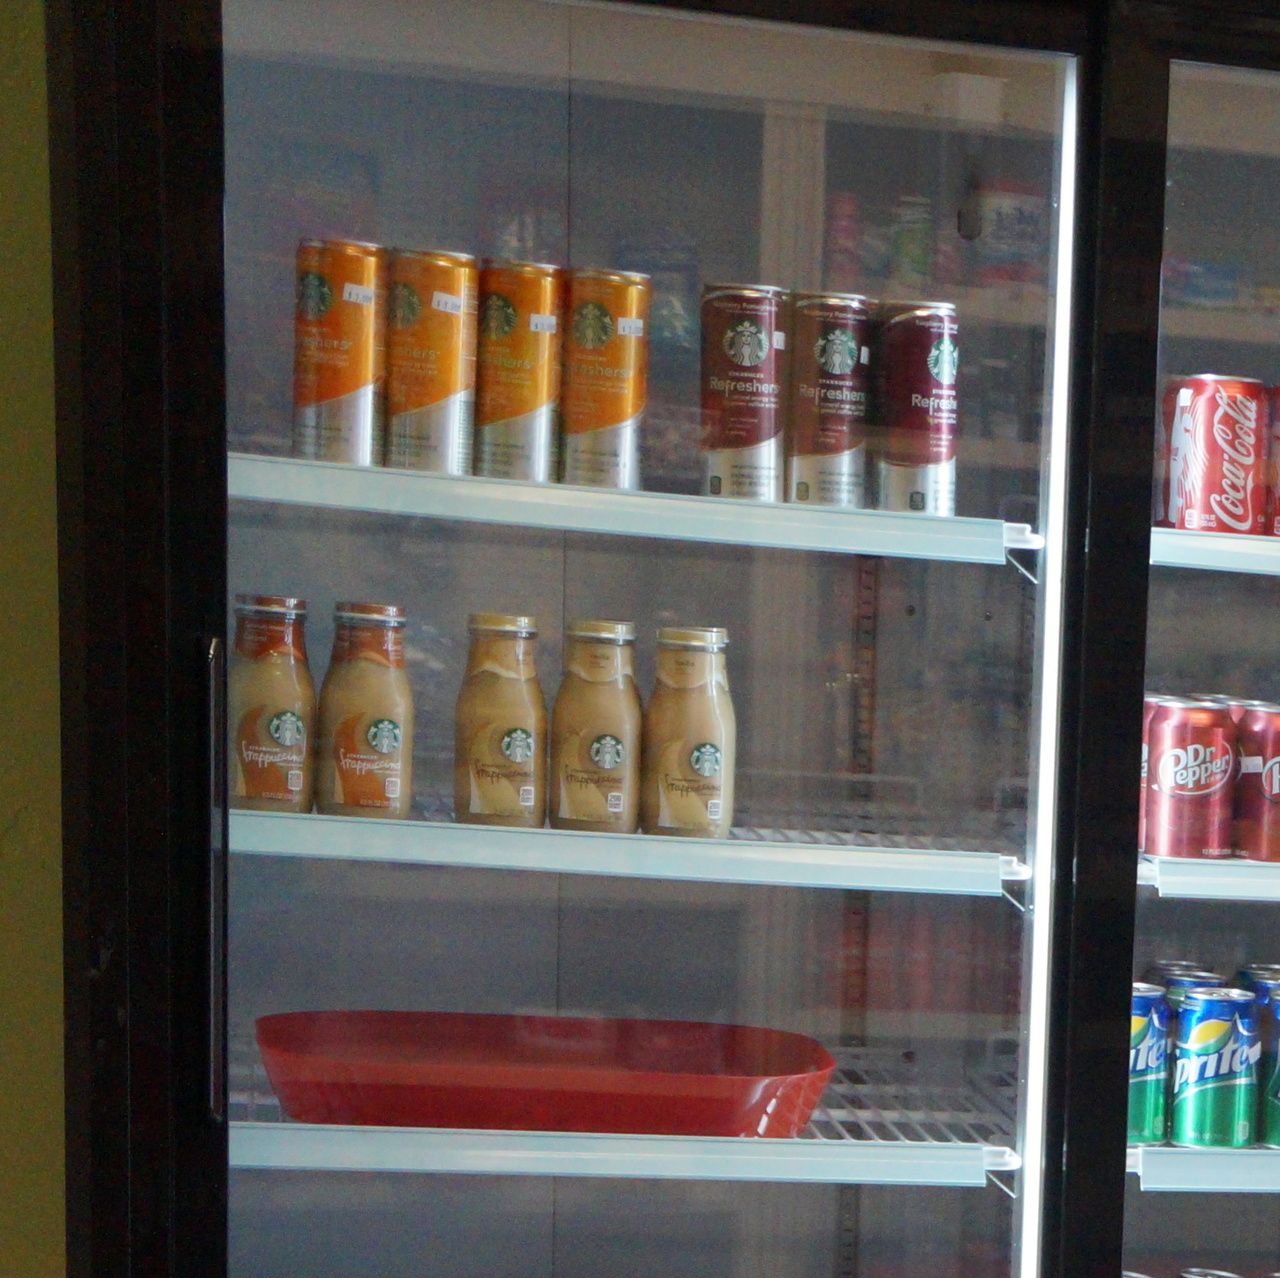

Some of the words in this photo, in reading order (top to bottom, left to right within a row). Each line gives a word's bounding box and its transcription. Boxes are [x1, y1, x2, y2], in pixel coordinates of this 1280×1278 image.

[710, 376, 780, 397] Refreshers
[911, 393, 957, 416] Refresh
[1209, 386, 1258, 532] Coca-Cola
[1160, 748, 1231, 790] Pepper
[1186, 744, 1216, 767] Dr
[1173, 1037, 1256, 1094] prite
